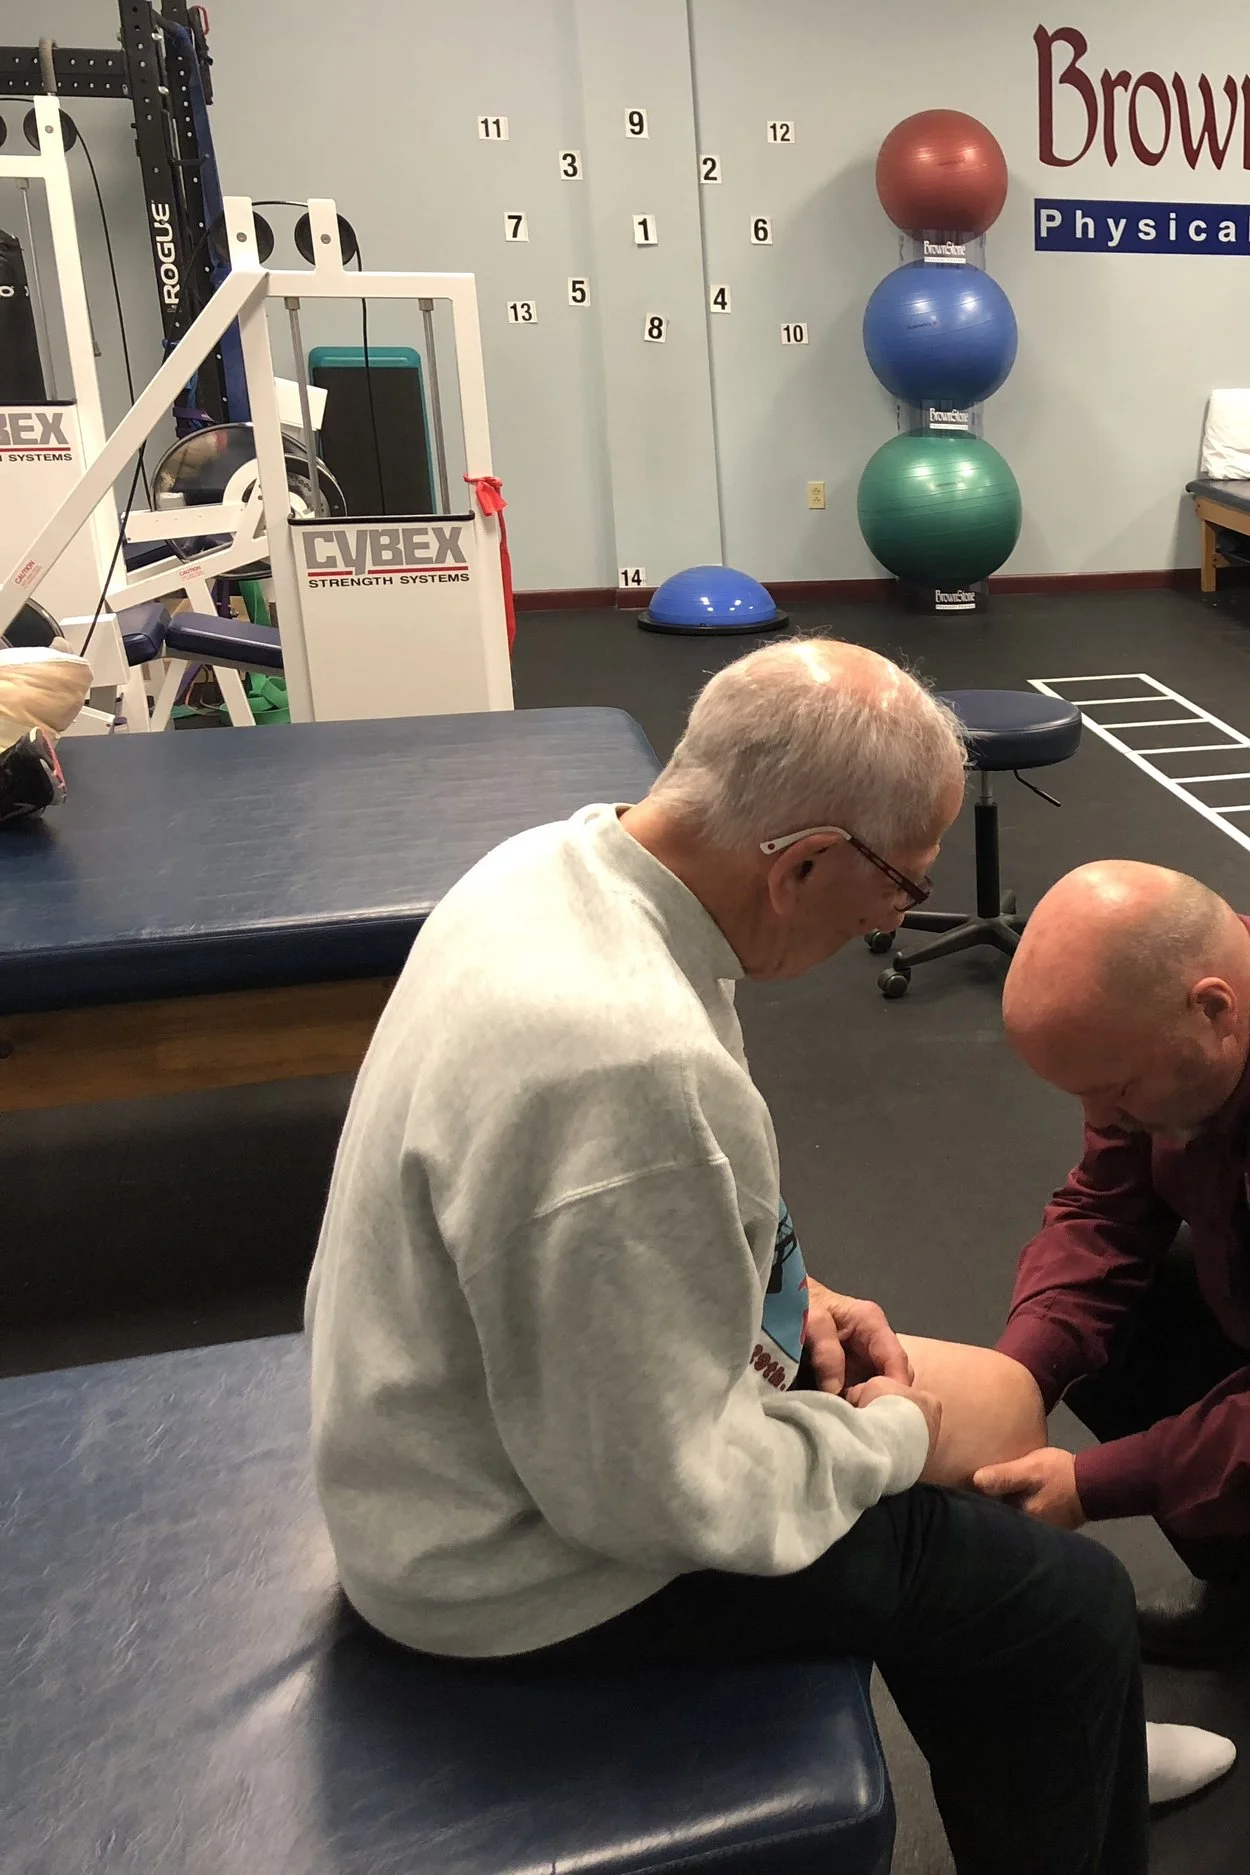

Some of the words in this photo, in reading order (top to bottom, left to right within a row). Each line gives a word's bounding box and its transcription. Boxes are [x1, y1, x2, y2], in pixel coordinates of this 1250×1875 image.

[480, 118, 502, 139] 11
[628, 110, 645, 136] 9
[769, 123, 791, 143] 12
[561, 153, 579, 178] 3
[702, 157, 718, 181] 2
[507, 214, 523, 239] 7
[637, 218, 650, 242] 1
[753, 218, 769, 242] 6
[152, 204, 180, 304] ROGUE
[571, 280, 587, 304] 5
[713, 287, 728, 310] 4
[510, 302, 533, 322] 13
[648, 316, 663, 340] 8
[783, 324, 804, 343] 10
[8, 453, 73, 462] SYSTEMS
[302, 527, 467, 576] CYBEX
[15, 560, 35, 584] CAUTION
[309, 577, 393, 588] STRENGTH
[400, 573, 470, 585] SYSTEMS
[620, 569, 642, 587] 14
